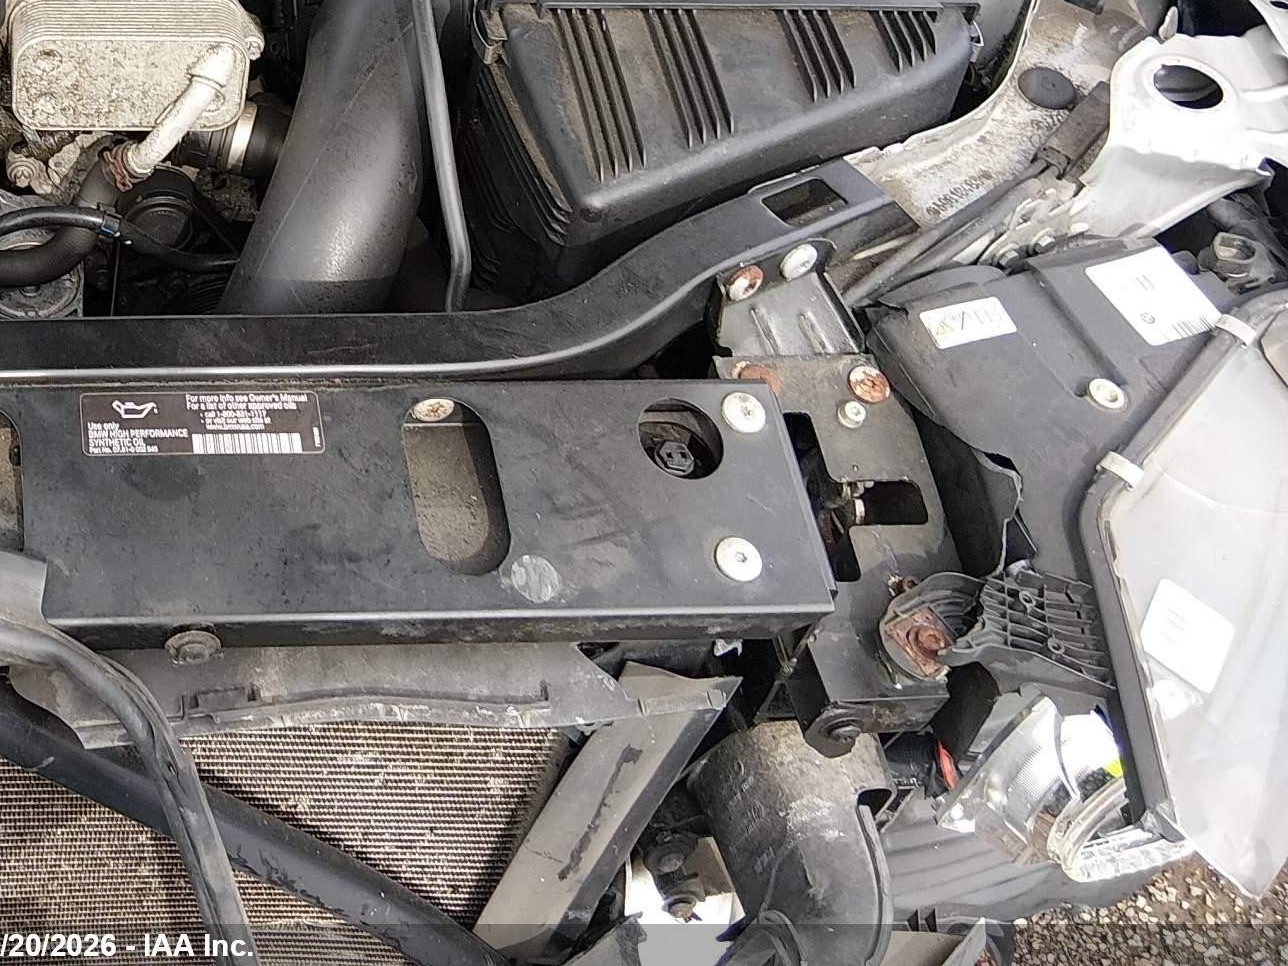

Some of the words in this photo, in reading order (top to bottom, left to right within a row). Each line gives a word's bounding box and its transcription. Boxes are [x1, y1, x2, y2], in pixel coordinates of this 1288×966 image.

[186, 394, 198, 403] For
[199, 394, 219, 403] more
[248, 394, 279, 403] Owner's
[280, 394, 308, 403] Manual
[186, 402, 199, 410] For
[87, 422, 102, 430] Use
[103, 422, 120, 432] only
[88, 430, 108, 439] BMW
[109, 429, 129, 438] HIGH
[130, 429, 189, 438] PERFORMANCE
[88, 438, 132, 447] SYNTHETIC
[132, 438, 146, 446] OIL
